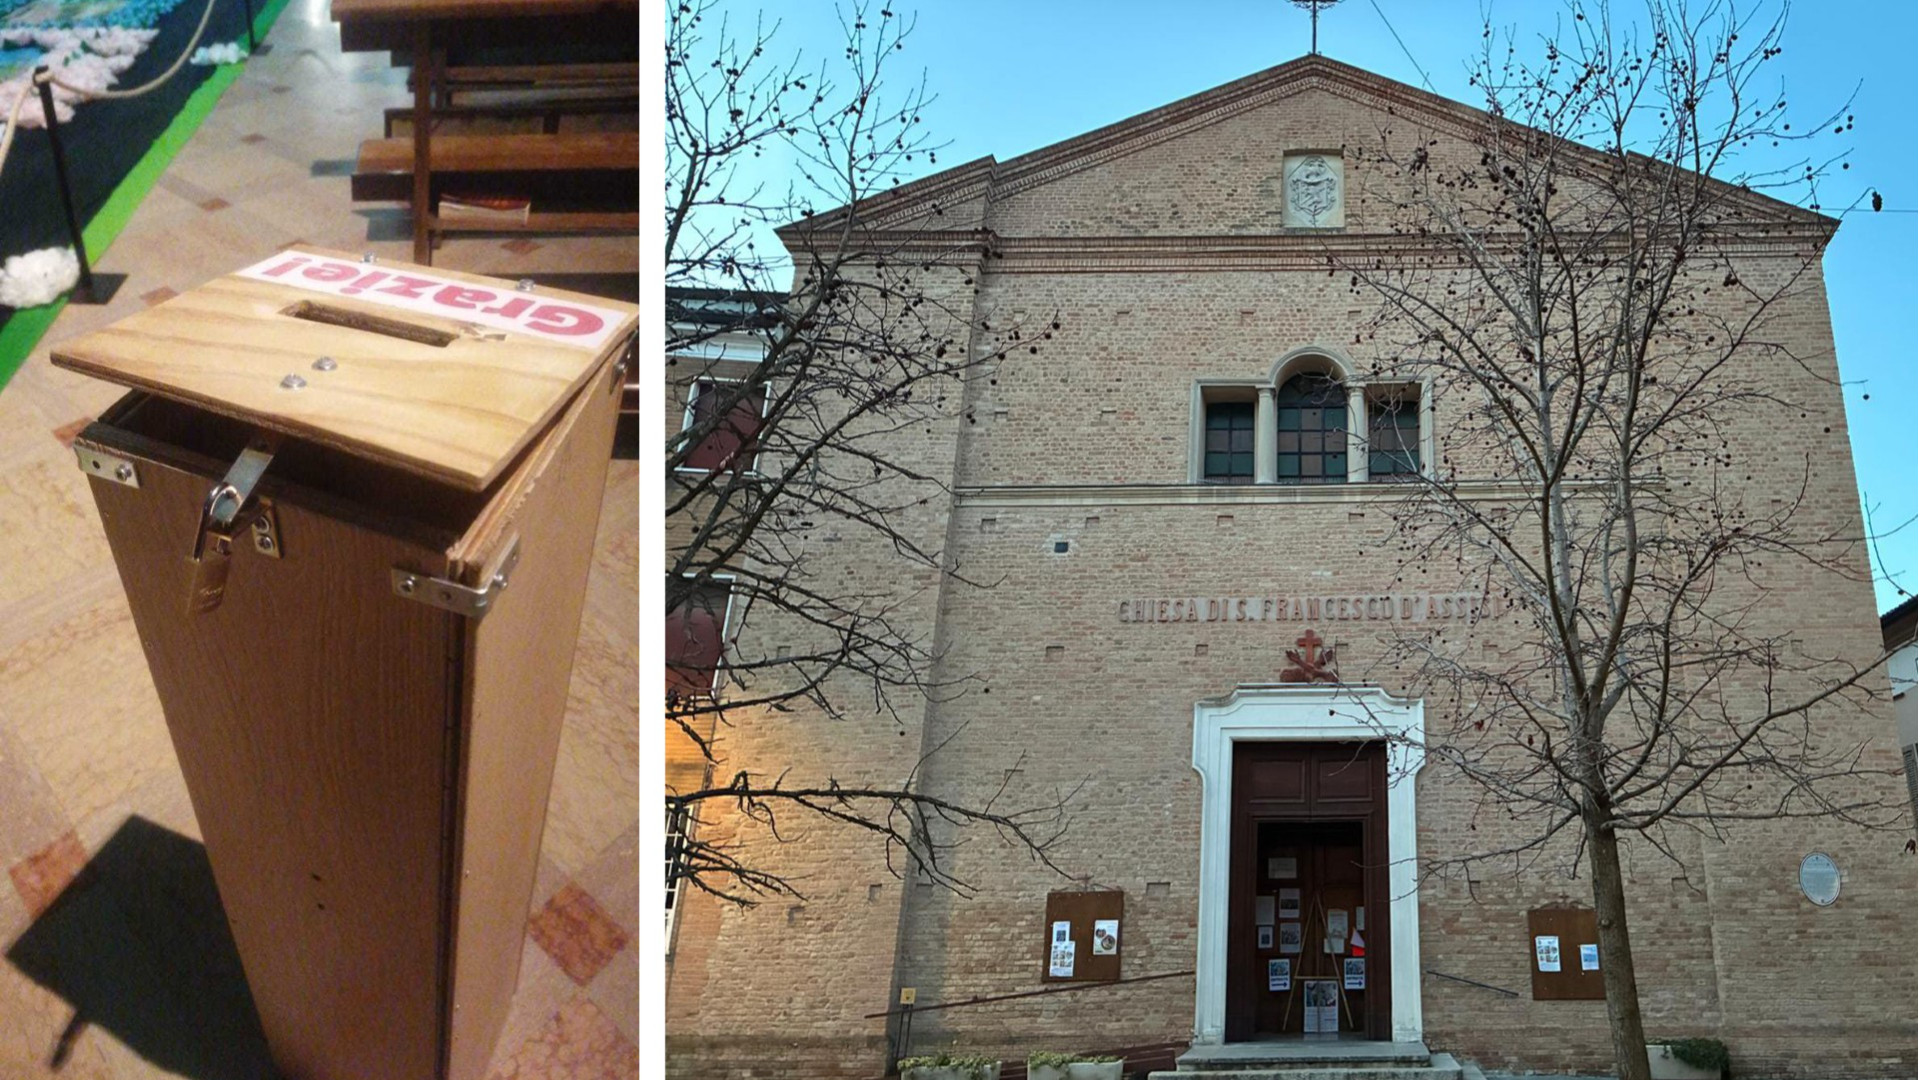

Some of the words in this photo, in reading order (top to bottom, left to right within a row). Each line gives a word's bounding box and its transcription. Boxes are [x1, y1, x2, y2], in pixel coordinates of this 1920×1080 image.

[261, 256, 605, 336] Grazie!
[1119, 599, 1198, 623] CHIESA
[1207, 599, 1229, 622] DI
[1236, 599, 1255, 622] S.
[1261, 597, 1394, 621] FRANCESCO
